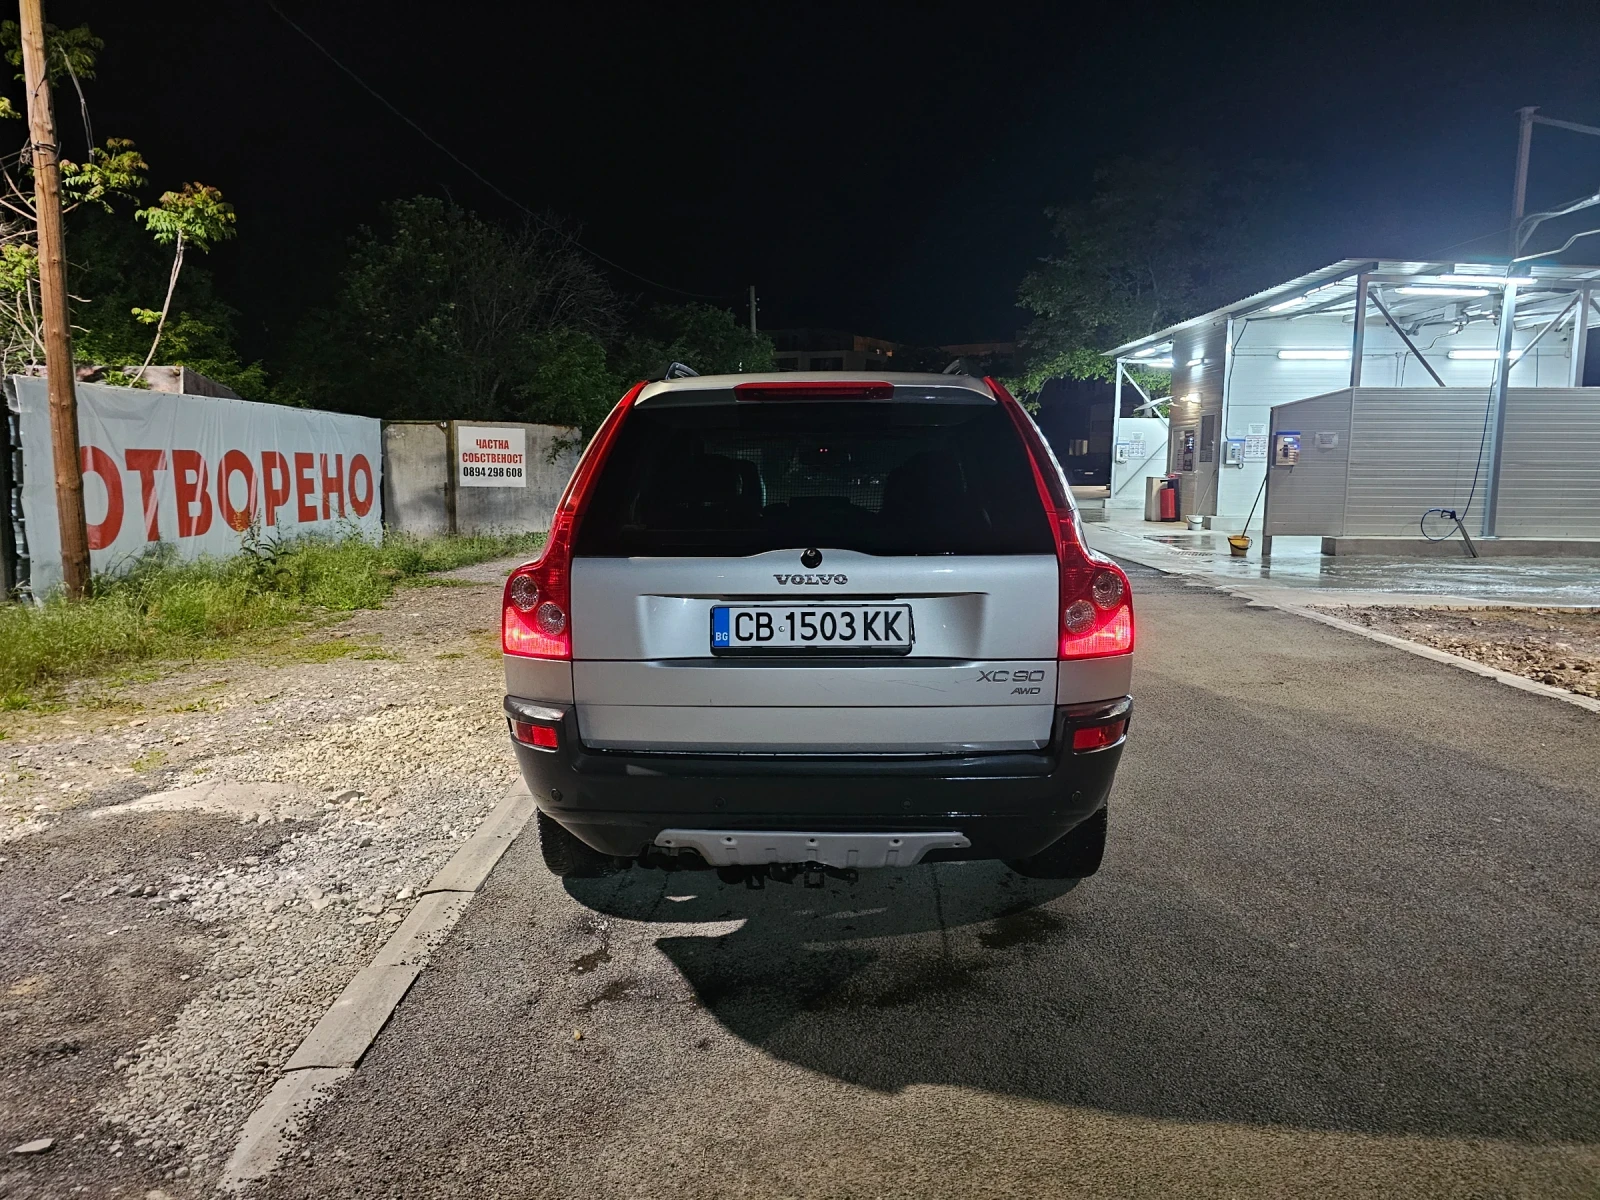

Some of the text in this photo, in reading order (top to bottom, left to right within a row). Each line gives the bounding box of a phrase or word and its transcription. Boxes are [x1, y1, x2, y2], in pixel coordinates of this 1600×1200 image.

[475, 438, 510, 450] ЧАСТНА
[462, 452, 523, 464] СОБСТВЕНОСТ
[463, 466, 523, 478] 0894 298 608
[80, 445, 374, 551] ОТВОРЕНО
[773, 573, 848, 585] VOLVO
[735, 611, 904, 642] CB 1503 KK
[715, 631, 729, 641] BG
[1010, 687, 1041, 695] AWD
